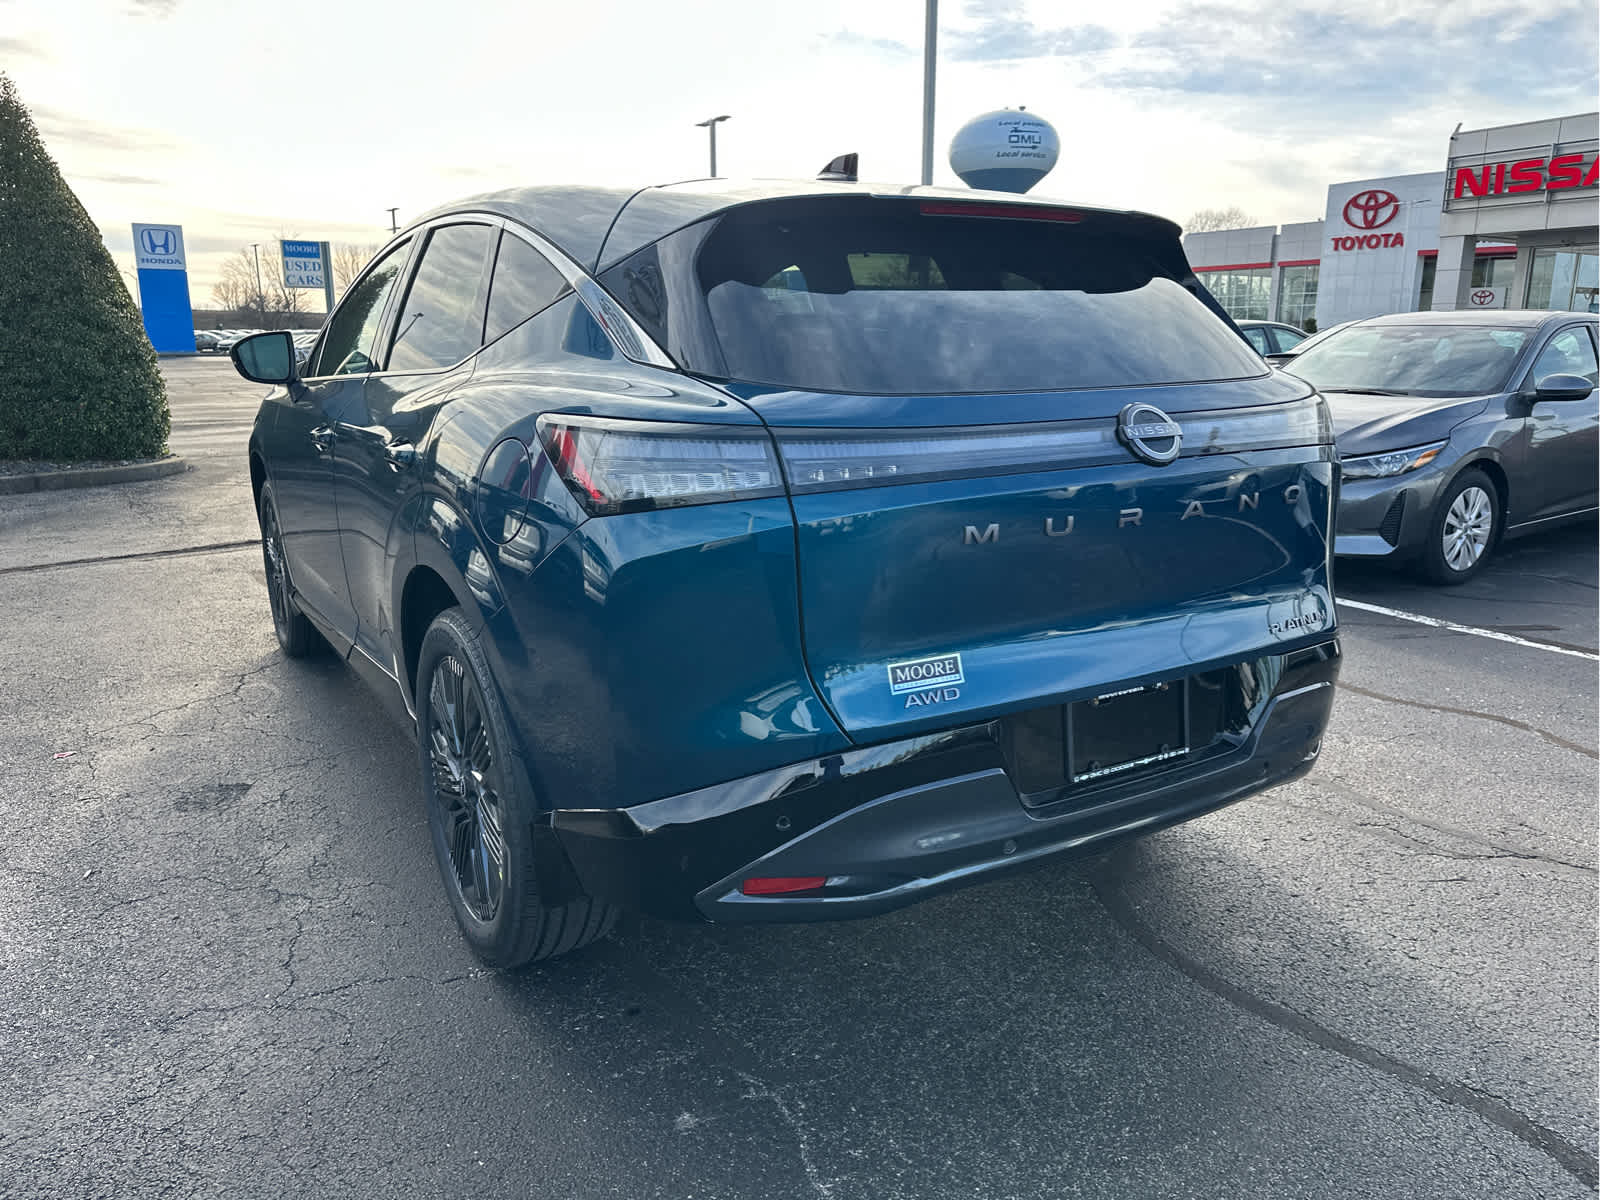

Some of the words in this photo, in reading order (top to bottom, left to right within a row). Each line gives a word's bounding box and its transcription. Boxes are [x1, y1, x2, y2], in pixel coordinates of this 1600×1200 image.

[1008, 135, 1042, 144] OMU
[996, 150, 1021, 159] Local
[1331, 233, 1404, 251] TOYOTA
[285, 244, 319, 254] MOORE
[141, 257, 182, 265] HONDA
[285, 260, 321, 273] USED
[286, 273, 323, 286] CARS
[963, 484, 1300, 545] MURANO
[1269, 609, 1327, 635] PLATINUM
[895, 659, 956, 683] MOORE
[904, 687, 961, 710] AWD
